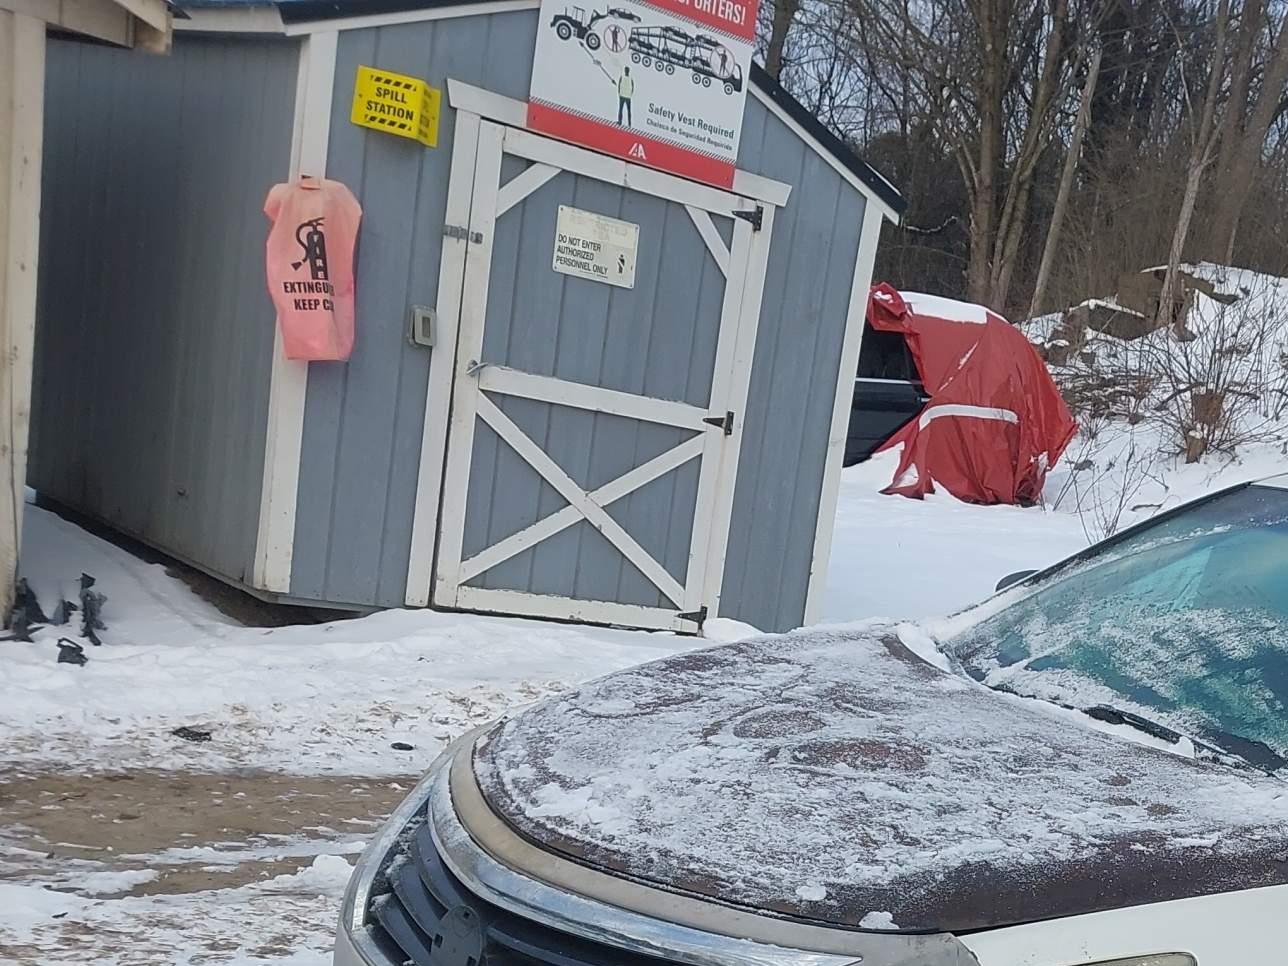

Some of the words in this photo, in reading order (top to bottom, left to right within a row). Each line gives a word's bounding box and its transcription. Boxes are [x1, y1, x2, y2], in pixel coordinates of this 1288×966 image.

[375, 87, 407, 104] SPILL
[366, 101, 414, 121] STATION
[648, 103, 675, 122] Safety
[678, 112, 696, 127] Vest
[697, 119, 735, 140] Required
[559, 234, 567, 243] DO
[568, 237, 580, 246] NOT
[582, 240, 601, 252] ENTER
[557, 245, 594, 261] AUTHORIZED
[556, 255, 591, 271] PERSONNEL
[592, 264, 608, 275] ONLY
[293, 298, 320, 311] KEEP
